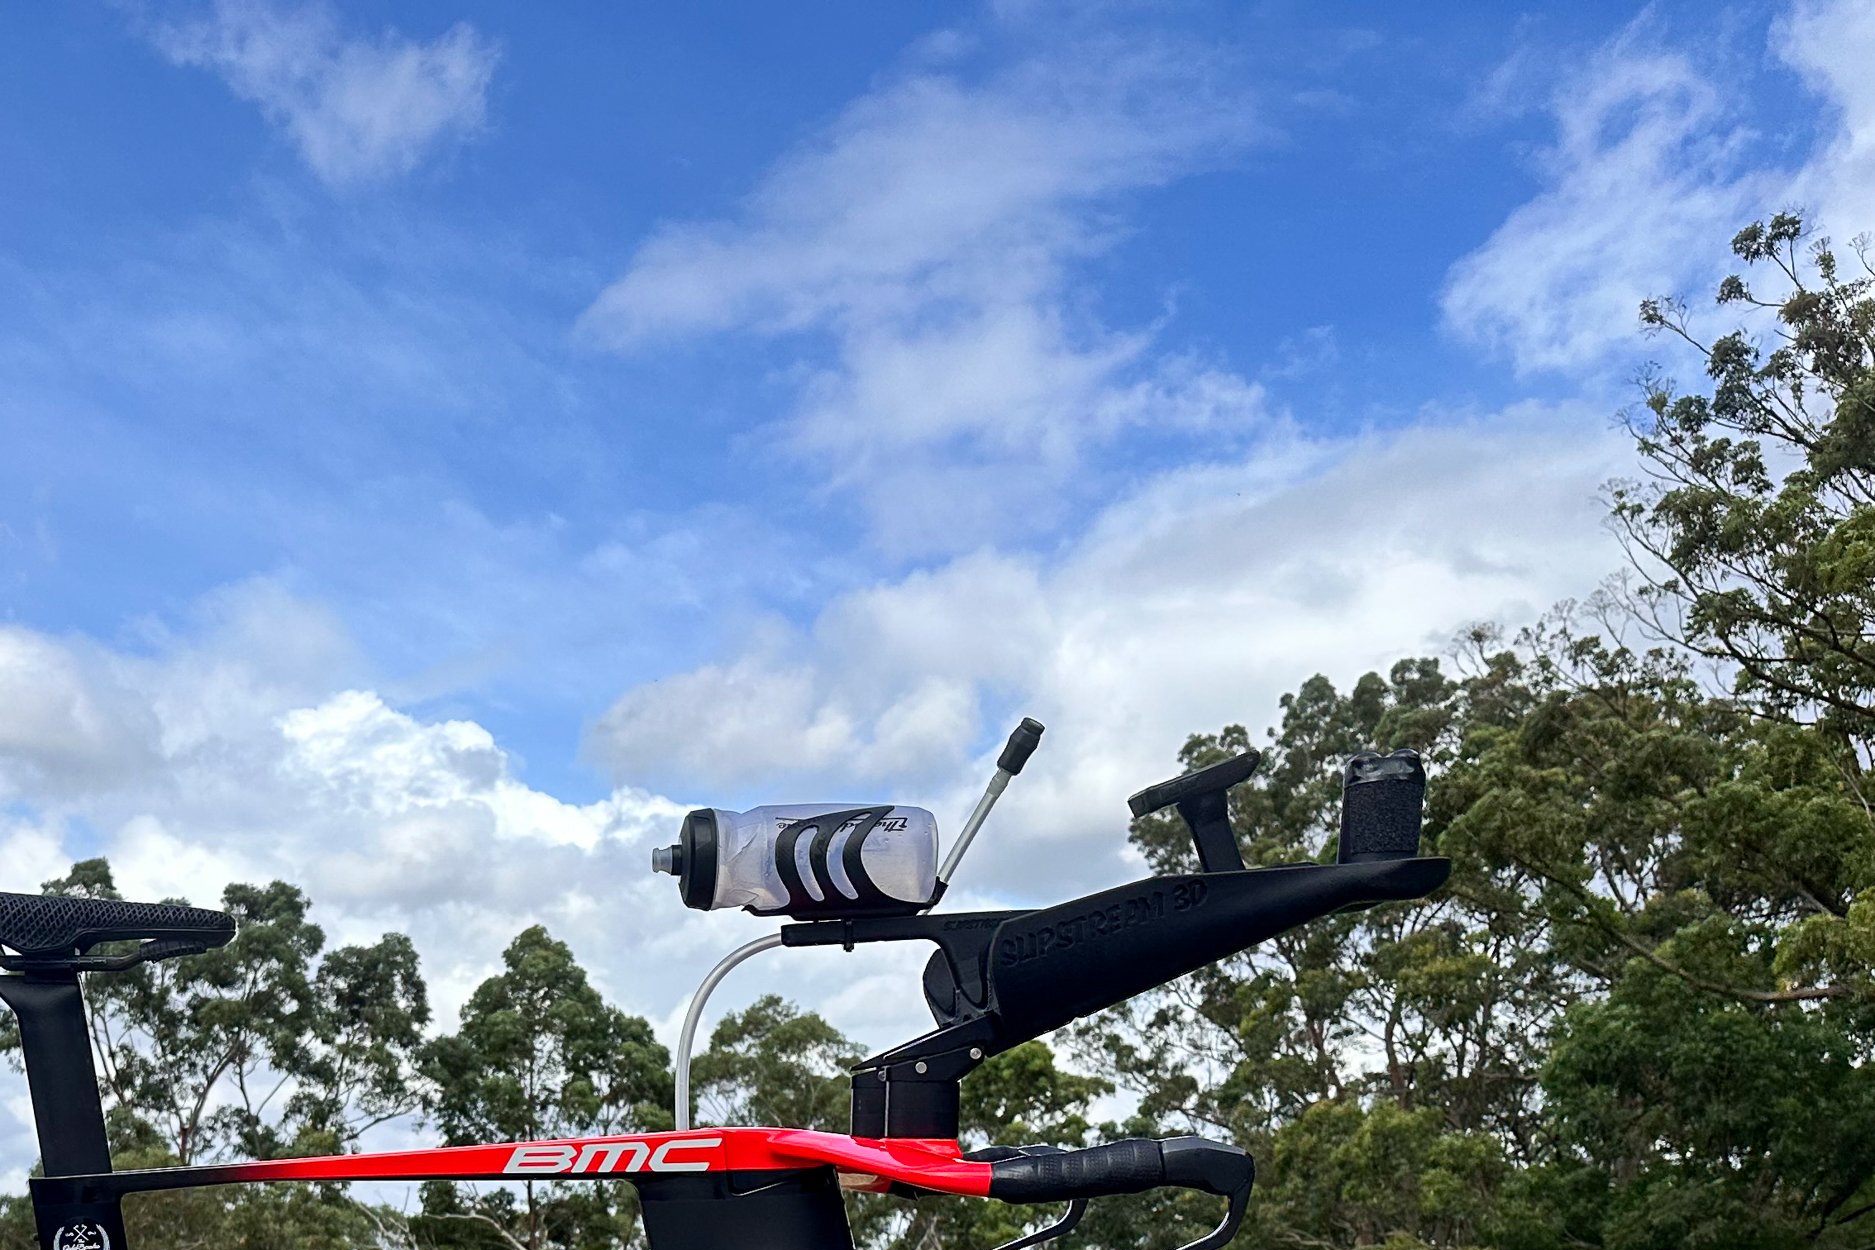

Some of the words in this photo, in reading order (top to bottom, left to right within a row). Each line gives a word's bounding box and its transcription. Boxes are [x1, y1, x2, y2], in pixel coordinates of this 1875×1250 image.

[1000, 891, 1166, 967] SLIPSTREAM
[1171, 879, 1209, 912] 3D
[502, 1138, 723, 1174] BMC
